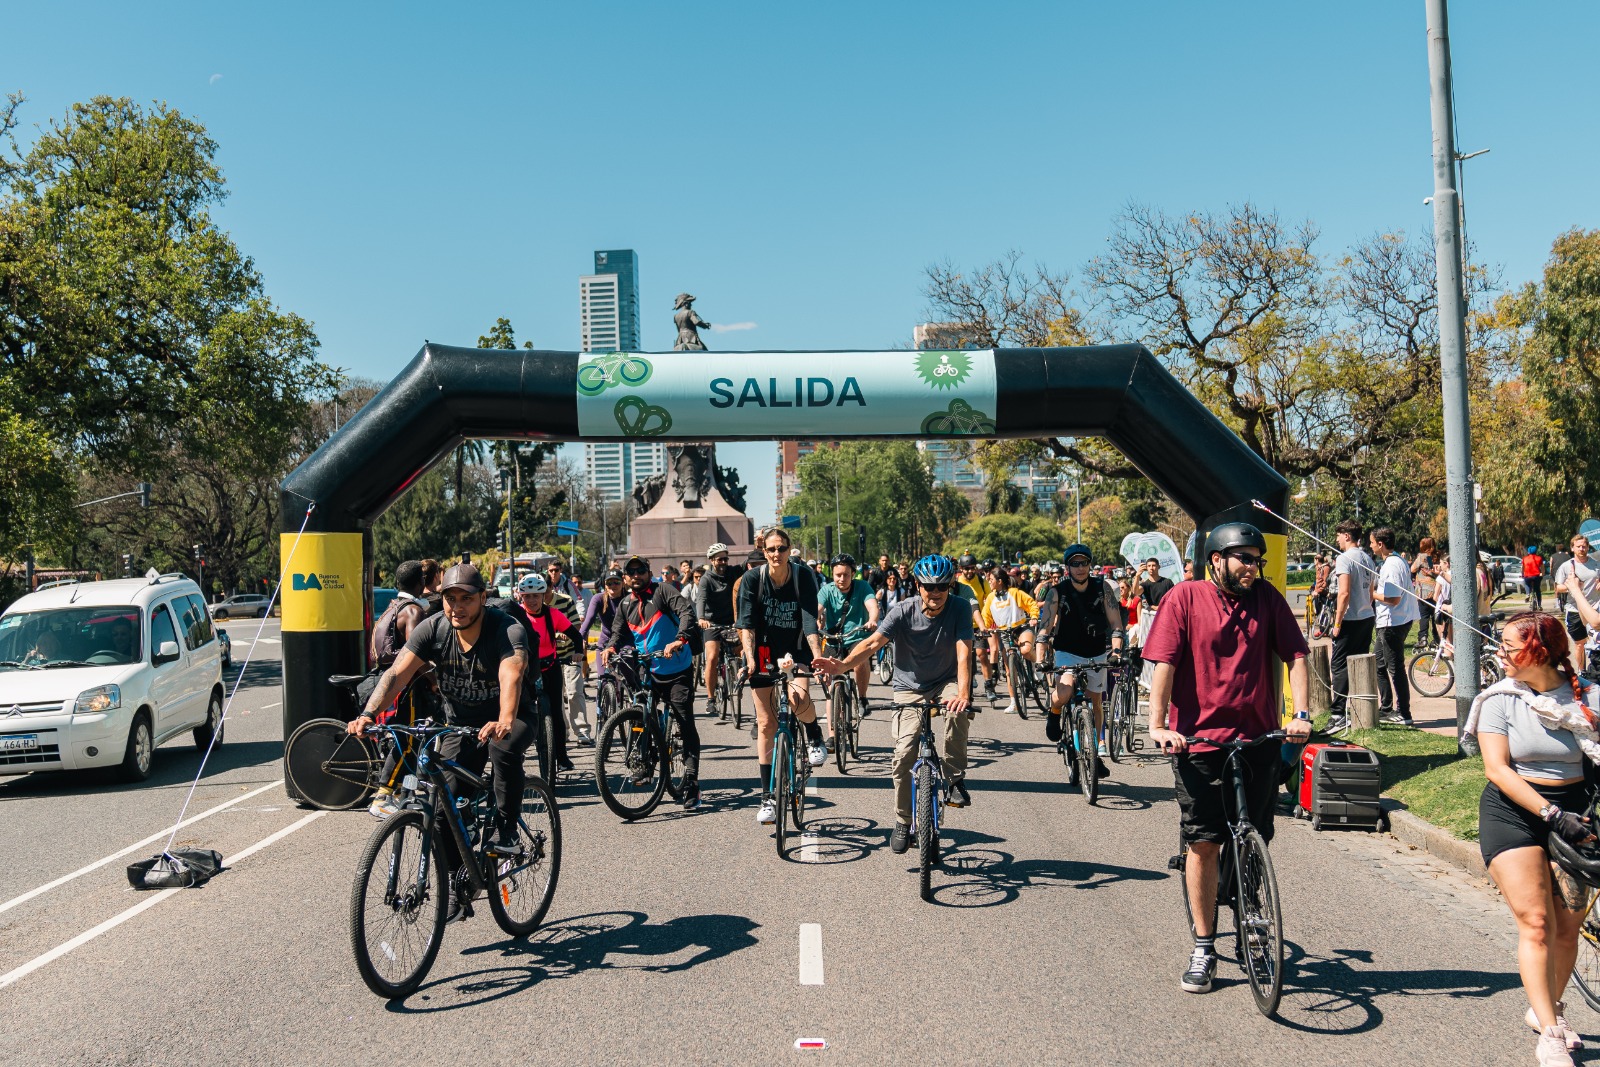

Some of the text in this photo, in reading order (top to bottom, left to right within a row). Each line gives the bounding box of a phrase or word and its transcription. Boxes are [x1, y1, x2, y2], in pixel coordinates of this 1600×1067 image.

[709, 376, 867, 409] SALIDA
[293, 573, 322, 590] BA
[4, 740, 35, 749] 464 HJ
